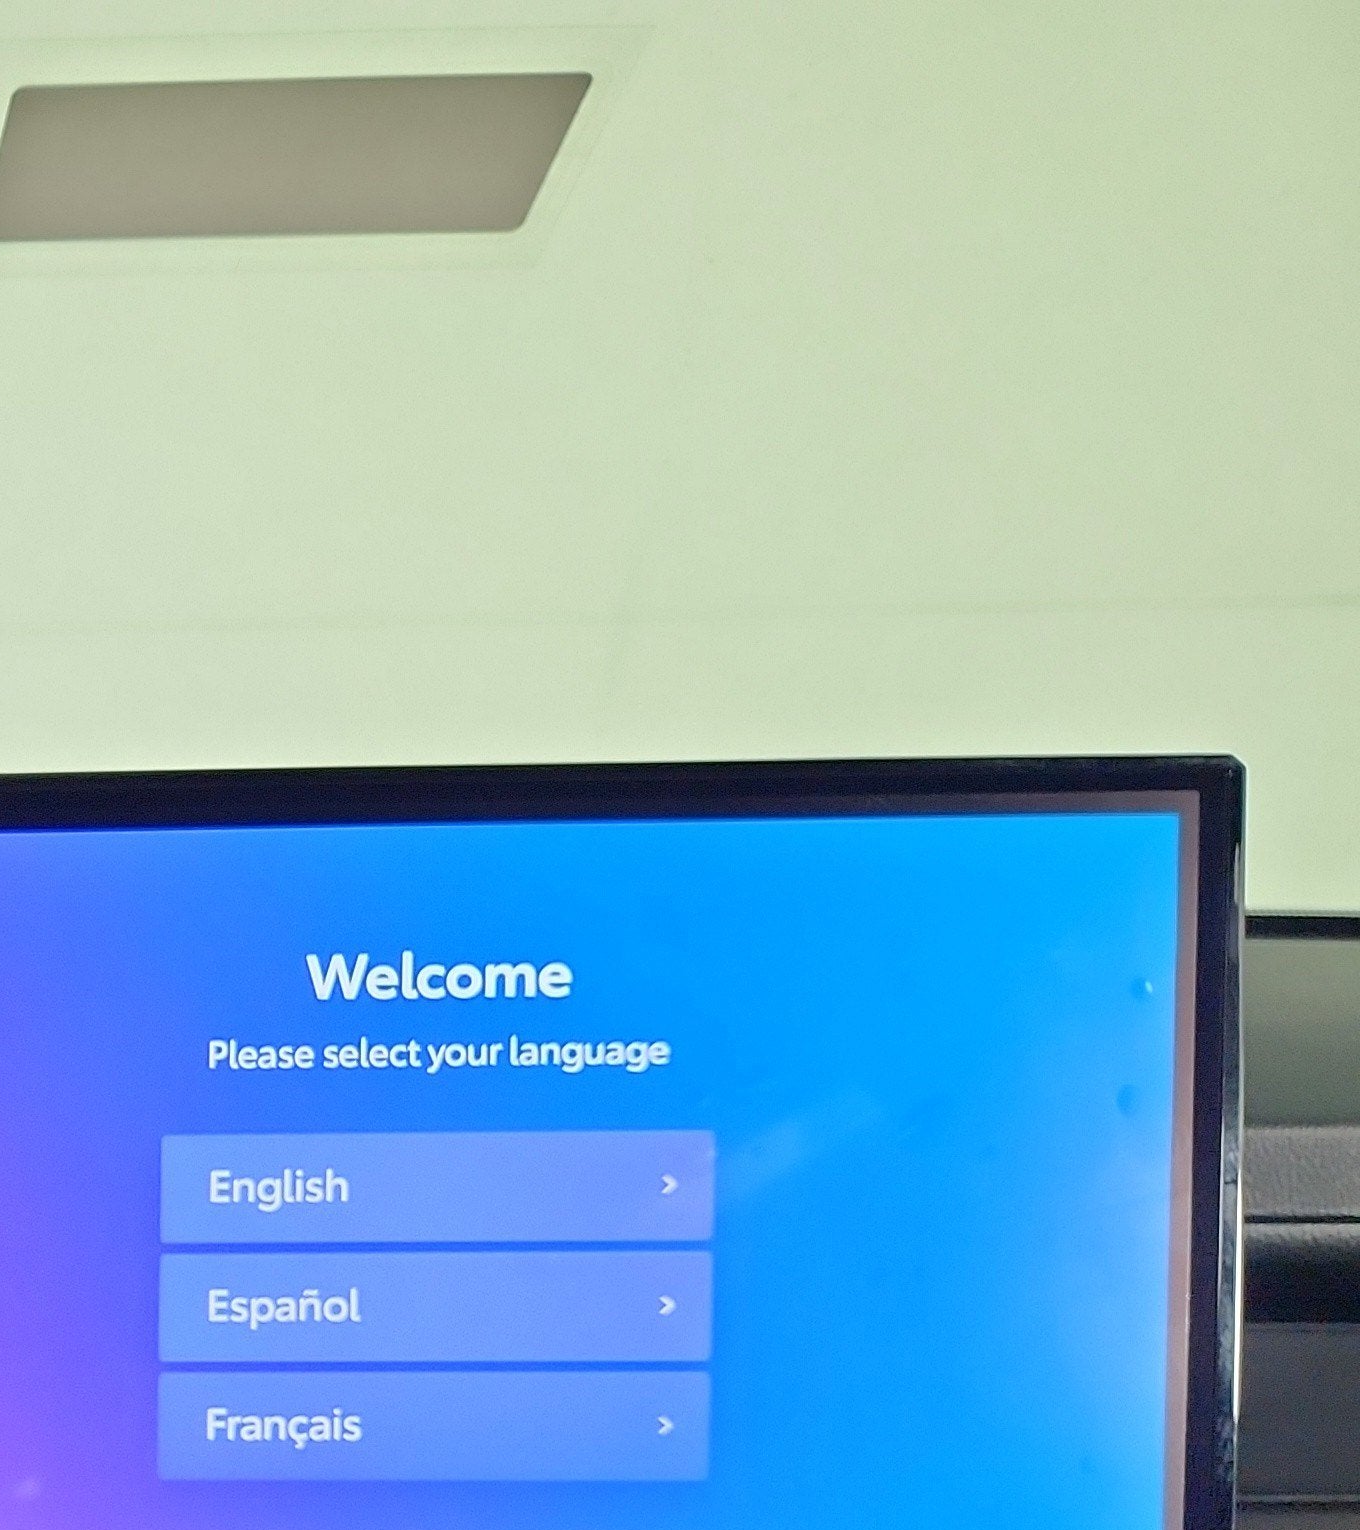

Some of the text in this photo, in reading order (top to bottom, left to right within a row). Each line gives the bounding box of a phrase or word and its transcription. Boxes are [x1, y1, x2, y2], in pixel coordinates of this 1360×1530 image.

[306, 950, 574, 1001] Welcome
[207, 1035, 672, 1074] Please select your language
[209, 1169, 350, 1212] English
[207, 1288, 361, 1330] Español
[206, 1408, 362, 1449] Français
